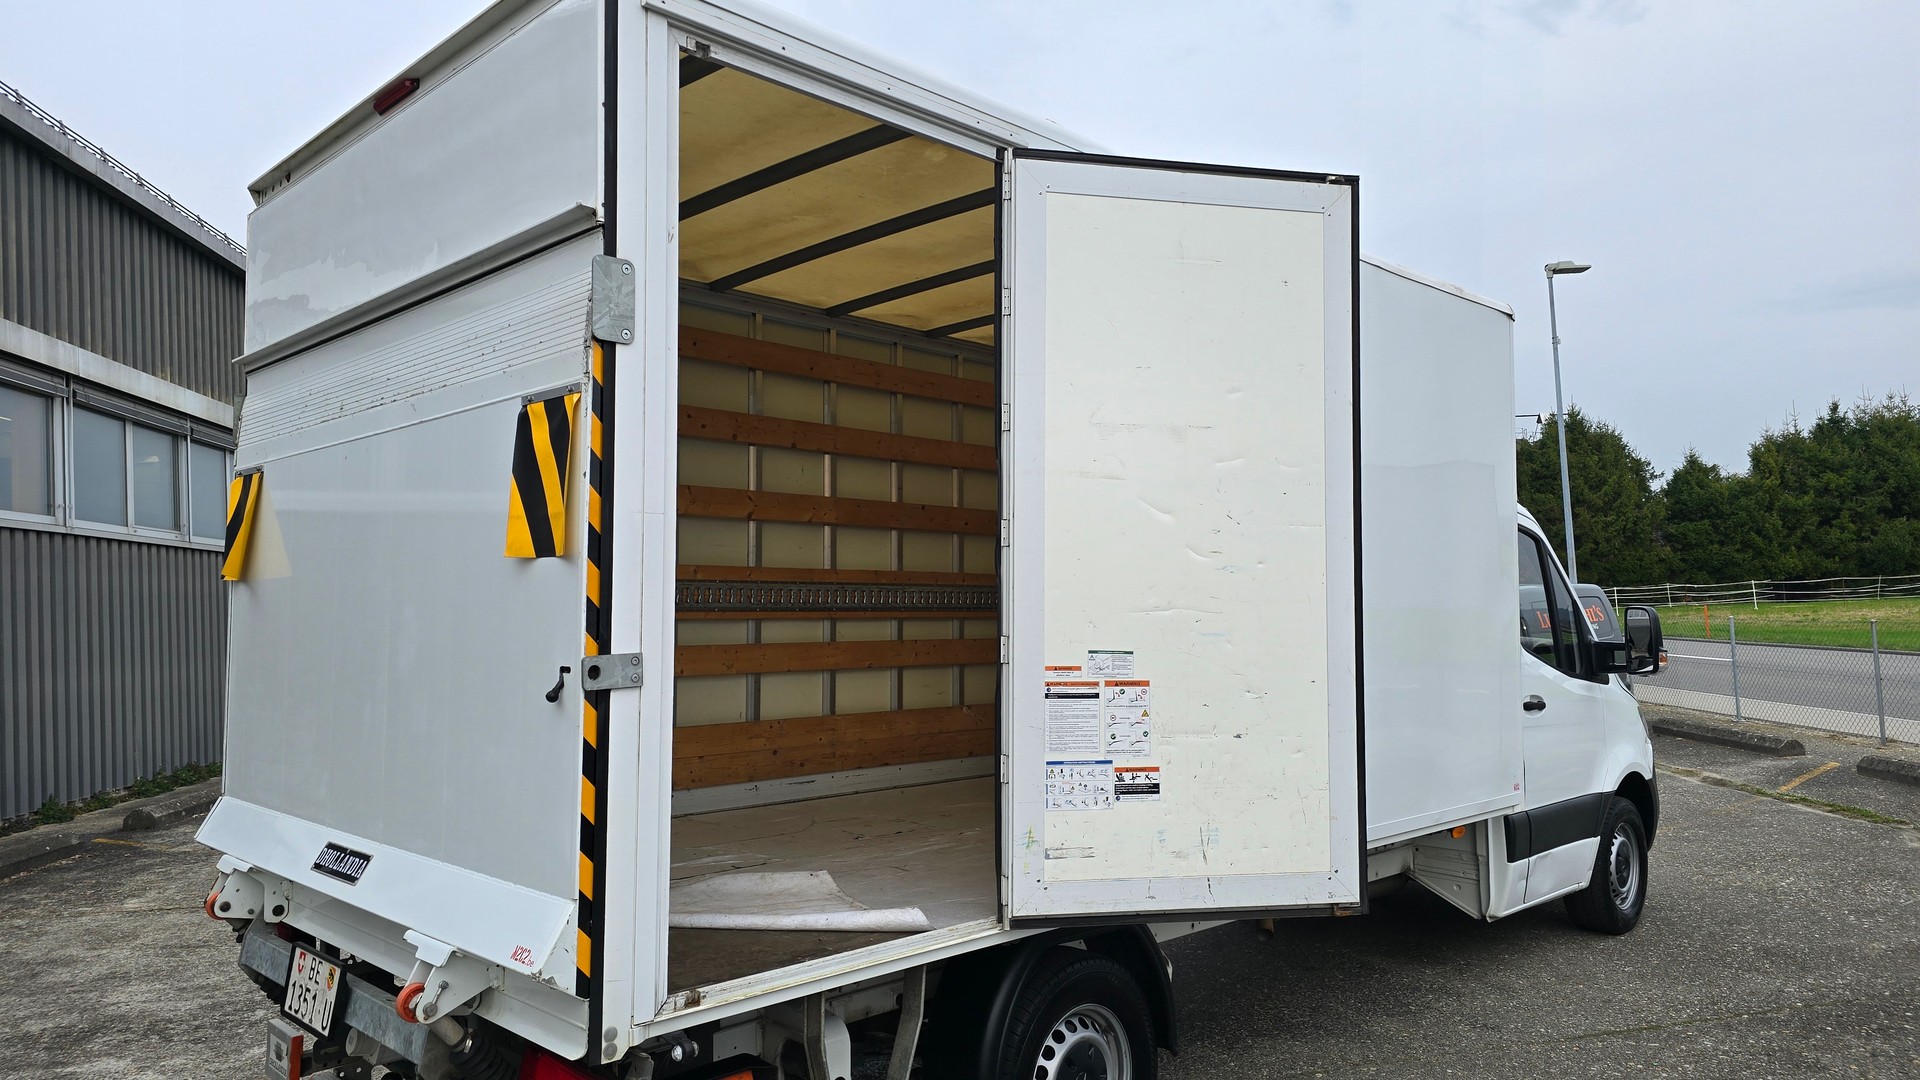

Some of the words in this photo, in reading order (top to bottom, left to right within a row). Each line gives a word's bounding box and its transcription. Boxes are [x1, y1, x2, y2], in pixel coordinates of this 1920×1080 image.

[315, 847, 368, 879] DHOLLANDIA
[308, 957, 324, 985] BE
[288, 980, 318, 1025] 1351
